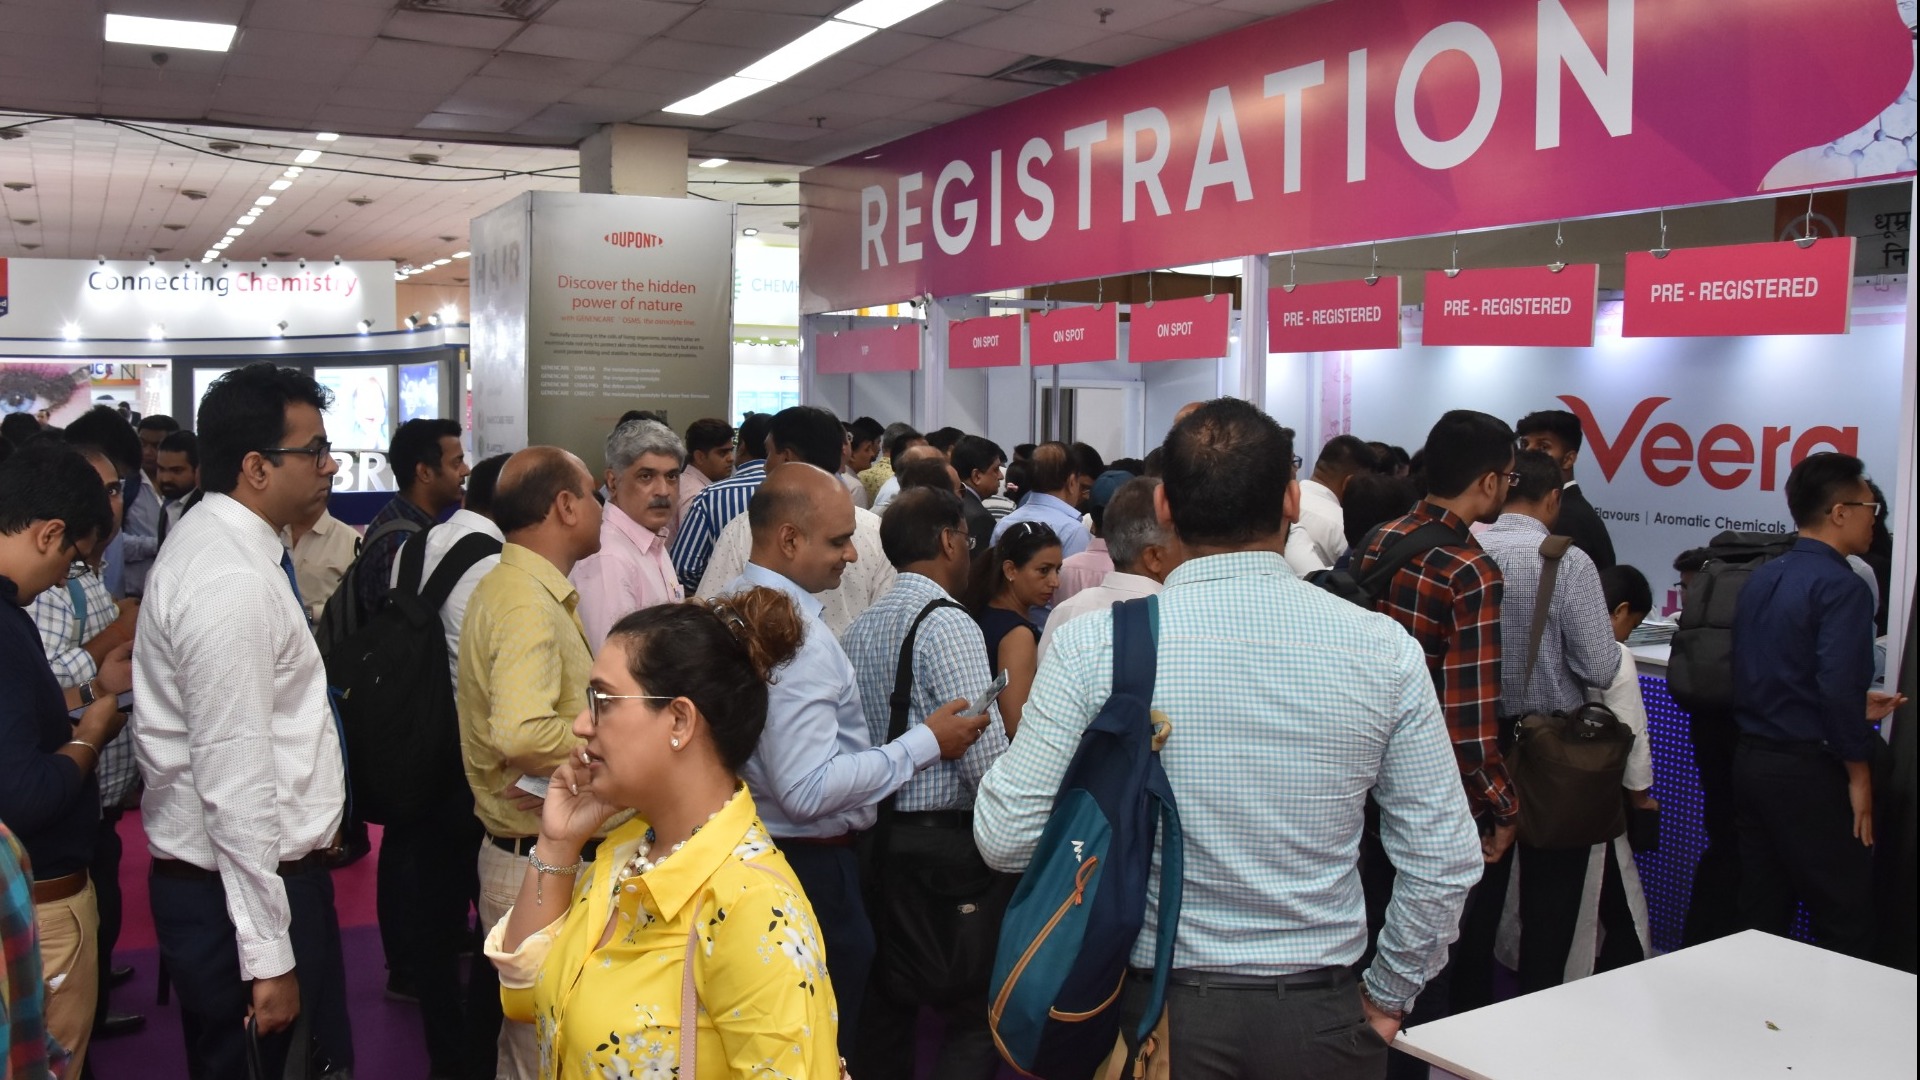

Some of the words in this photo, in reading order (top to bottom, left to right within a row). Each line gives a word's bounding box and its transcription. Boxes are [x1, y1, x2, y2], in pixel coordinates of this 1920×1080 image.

[861, 0, 1634, 270] REGISTRATION
[611, 231, 658, 248] DUPONT
[88, 271, 229, 297] Connecting
[236, 271, 358, 297] Chemistry
[557, 274, 618, 291] Discover
[621, 278, 645, 292] the
[648, 278, 696, 294] hidden
[1651, 283, 1684, 303] PRE
[1700, 276, 1819, 301] REGISTERED
[572, 297, 617, 311] power
[620, 296, 635, 310] of
[638, 299, 683, 312] nature
[1444, 300, 1470, 316] PRE
[1481, 297, 1571, 315] REGISTERED
[1283, 311, 1304, 327] PRE
[1312, 306, 1381, 325] REGISTERED
[1053, 330, 1064, 343] ON
[1065, 328, 1085, 342] SPOT
[1157, 323, 1170, 338] ON
[1171, 321, 1193, 337] SPOT
[973, 336, 983, 348] ON
[983, 335, 999, 348] SPOT
[1654, 512, 1710, 528] Aromatic
[1715, 516, 1786, 534] Chemicals
